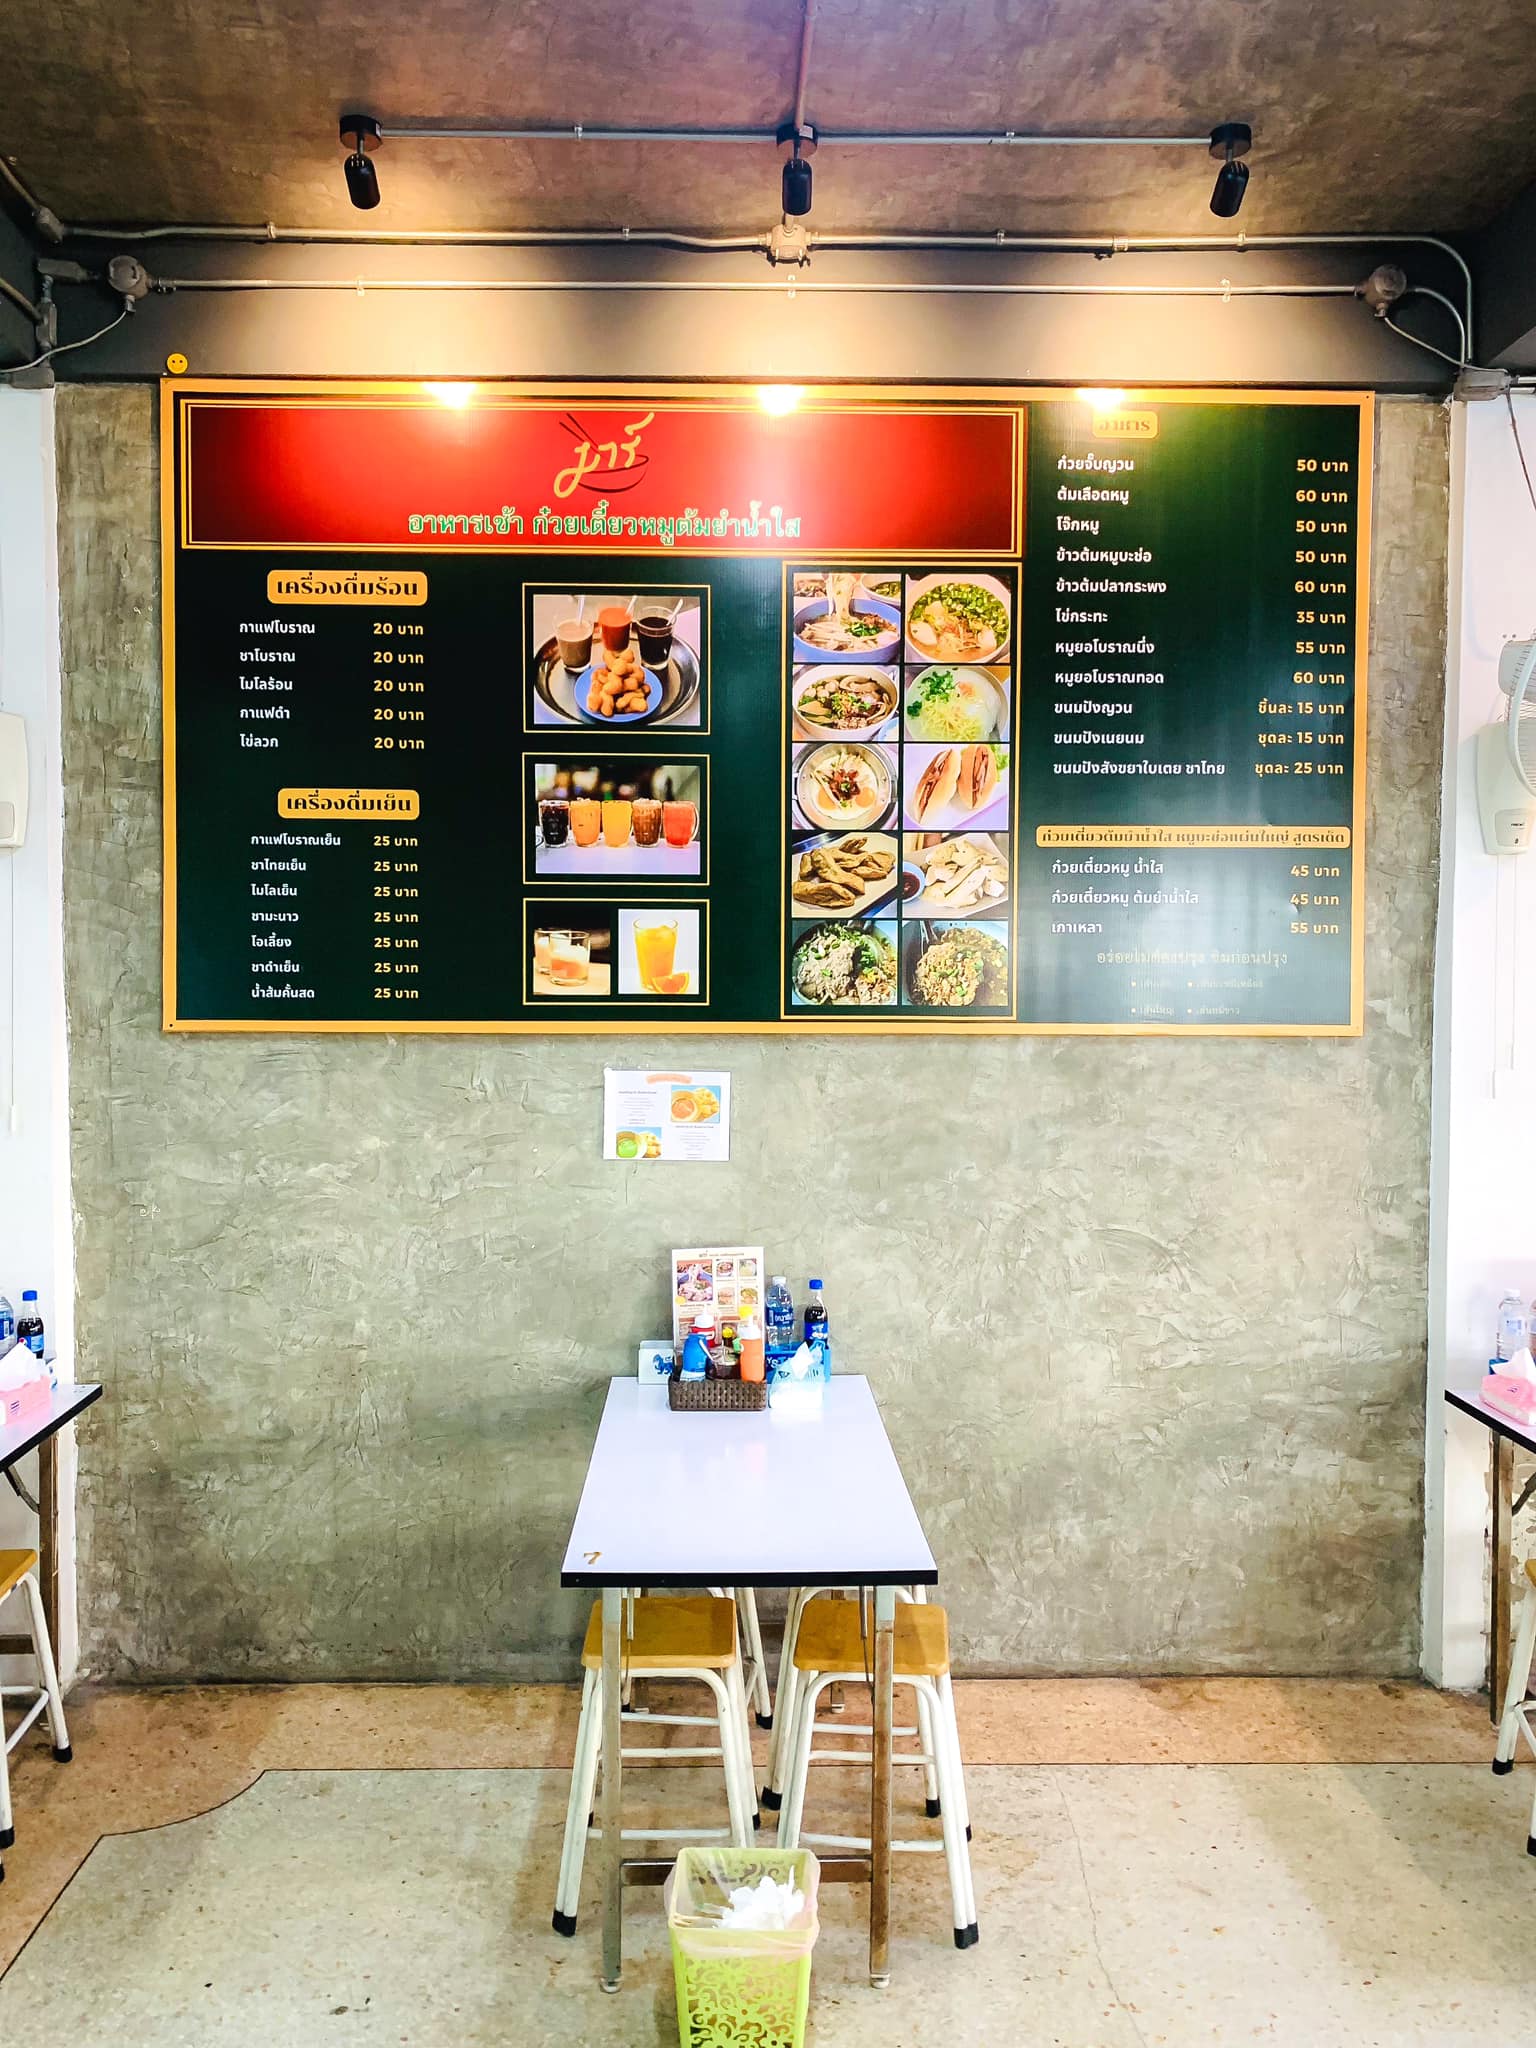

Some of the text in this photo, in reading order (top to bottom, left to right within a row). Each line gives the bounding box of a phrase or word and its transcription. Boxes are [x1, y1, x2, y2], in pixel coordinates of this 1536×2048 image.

[1296, 459, 1318, 472] 50
[1321, 461, 1349, 473] บาท
[1058, 486, 1348, 504] ต้มเลือดหมู 60 บาท
[407, 500, 802, 546] อาหารเช้า ก๋วยเตี๋ยวหมูต้มยำน้ำใส
[1057, 516, 1348, 535] โจ๊กหมู 50 บาท
[1057, 547, 1347, 565] ข้าวต้มหมูบะช่อ 50 บาท
[277, 572, 418, 596] เครื่องดื่มร้อน
[1056, 576, 1346, 594] ข้าวต้มปลากระพง 60 บาท
[1055, 607, 1346, 624] ไข่กระทะ 35 บาท
[239, 619, 424, 636] กาแฟโบราณ 20 บาท
[1056, 636, 1346, 656] หมูยอโบราณนึ่ง 55 บาท
[239, 647, 424, 664] ชาโบราณ 20 บาท
[239, 676, 424, 692] ไมโลร้อน 20 บาท
[1056, 669, 1345, 687] หมูยอโบราณทอด 60 บาท
[239, 705, 425, 721] กาแฟดำ 20 บาท
[1055, 697, 1345, 716] ขนมปังญวน ชิ้นละ 15 บาท
[239, 733, 425, 750] ไข่ลวก 20 บาท
[1053, 730, 1344, 748] ขนมปังเนยนม ชุดละ 15 บาท
[1053, 759, 1344, 778] ขนมปังสังขยาใบเตย ชาไทย ชุดละ 25 บาท
[287, 790, 411, 812] เครื่องดื่มเย็น
[250, 832, 418, 847] กาแฟโบราณเย็น 25 บาท
[251, 857, 418, 872] ชาไทยเย็น 25 บาท
[1052, 857, 1340, 877] ก๋วยเตี๋ยวหมู น้ำใส 45 บาท
[250, 883, 419, 897] ไมโลเย็น 25 บาท
[1052, 887, 1340, 907] ก๋วยเตี๋ยวหมู ต้มยำน้ำใส 45 บาท
[251, 911, 419, 923] ชามะนาว 25 บาท
[1051, 921, 1339, 935] เกาเหลา 55 บาท
[251, 931, 419, 948] โอเลี้ยง 25 บาท
[251, 959, 419, 974] ชาดำเย็น 25 บาท
[251, 982, 419, 999] น้ำส้มคั้นสด 25 บาท
[583, 1552, 602, 1565] 7
